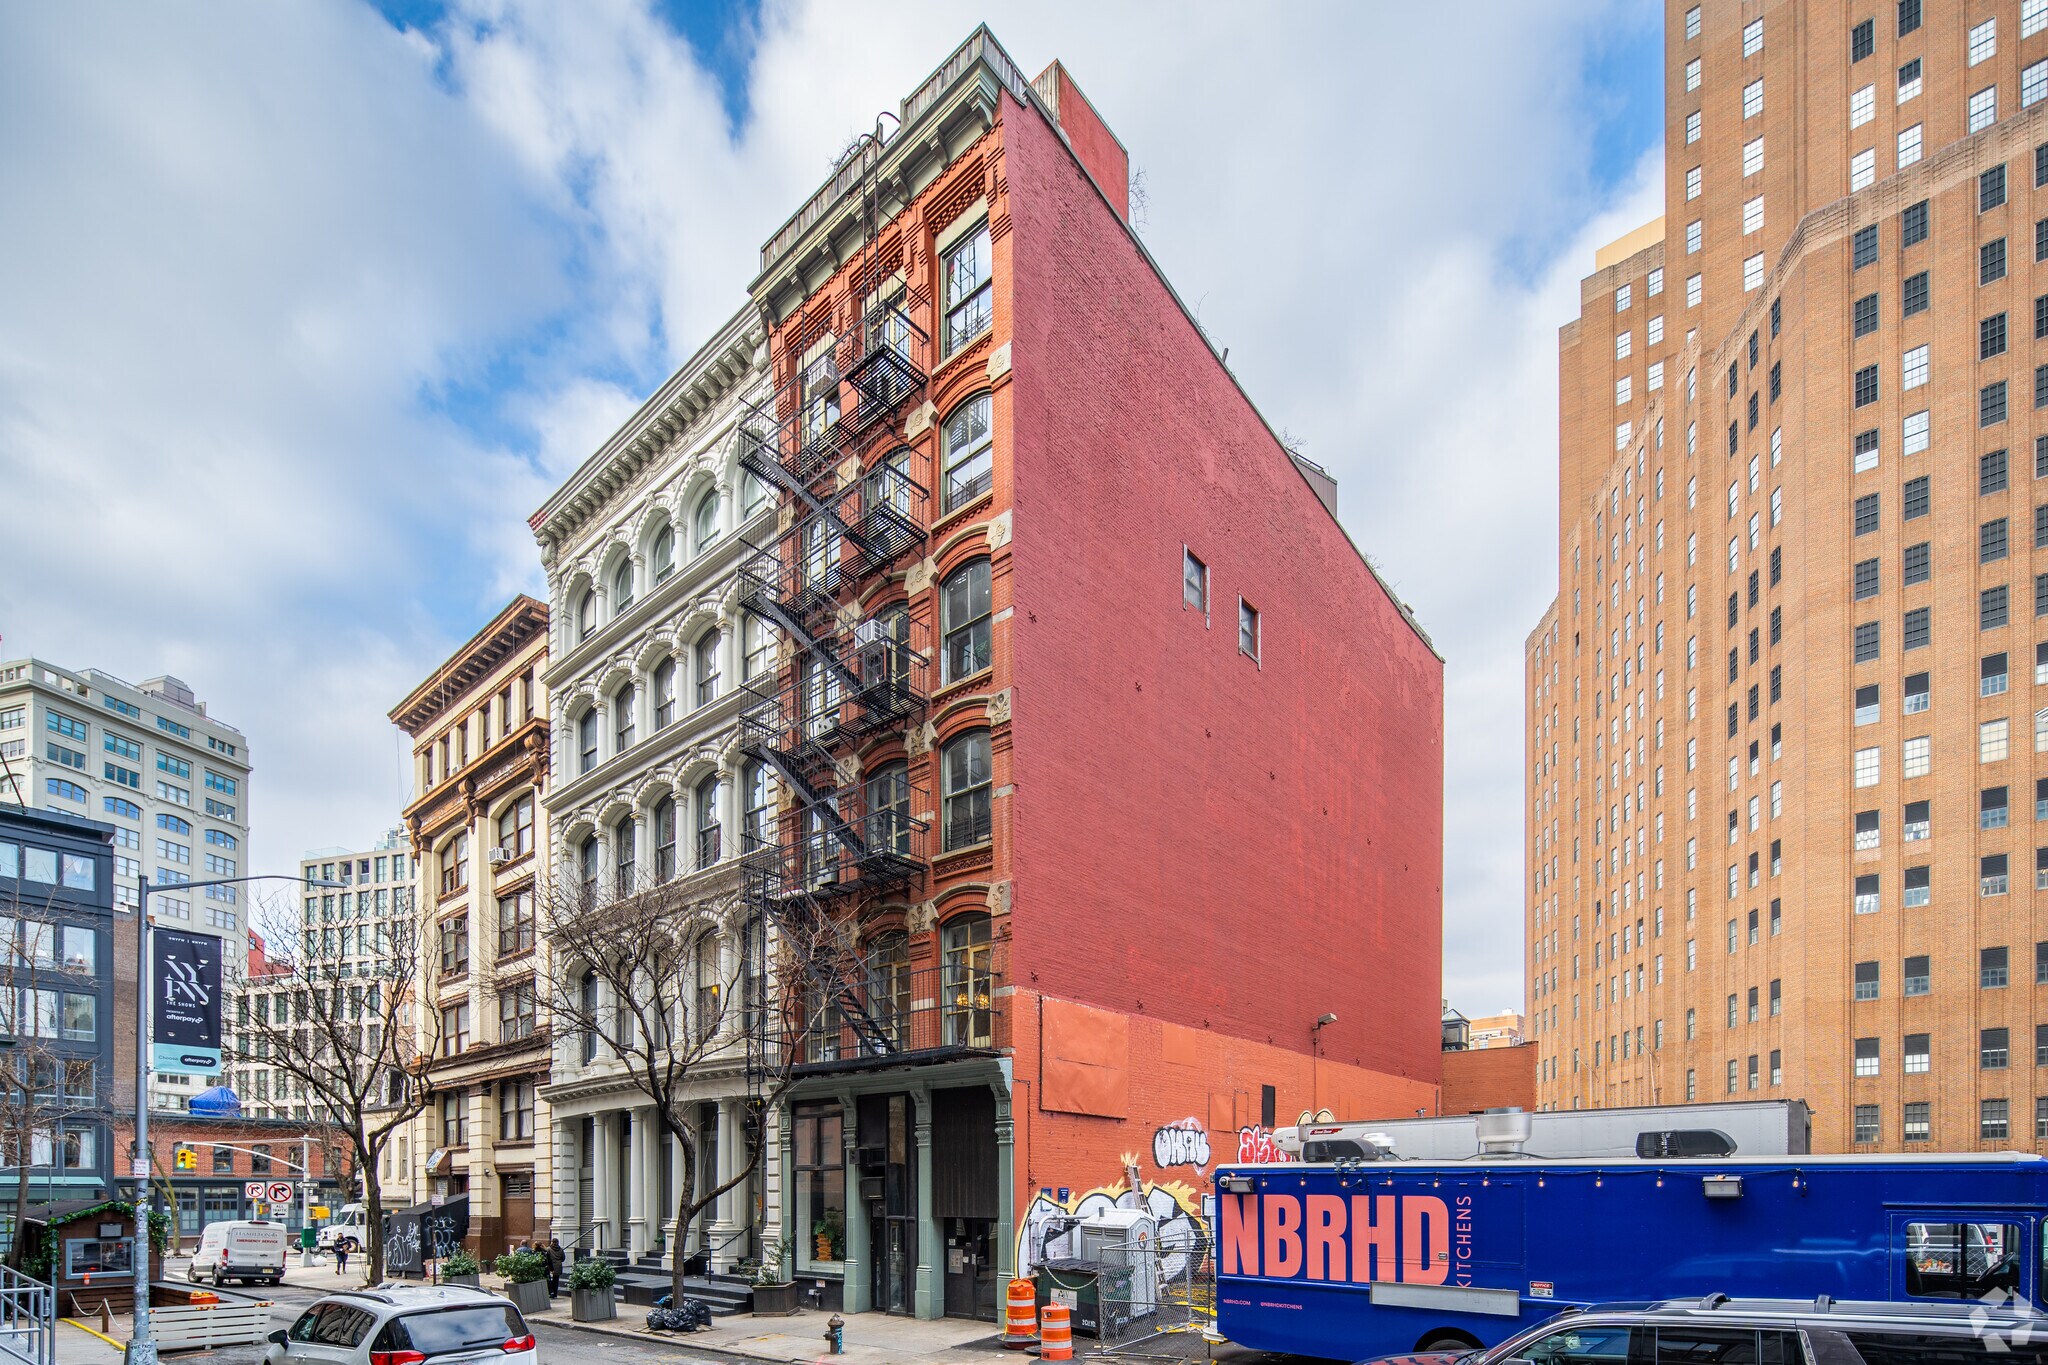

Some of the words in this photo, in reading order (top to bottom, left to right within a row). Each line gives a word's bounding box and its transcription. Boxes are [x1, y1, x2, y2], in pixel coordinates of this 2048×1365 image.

[166, 1014, 195, 1023] afterpay
[1221, 1193, 1449, 1287] NBRHD
[1260, 1302, 1303, 1310] @NBRHDKITCHENS
